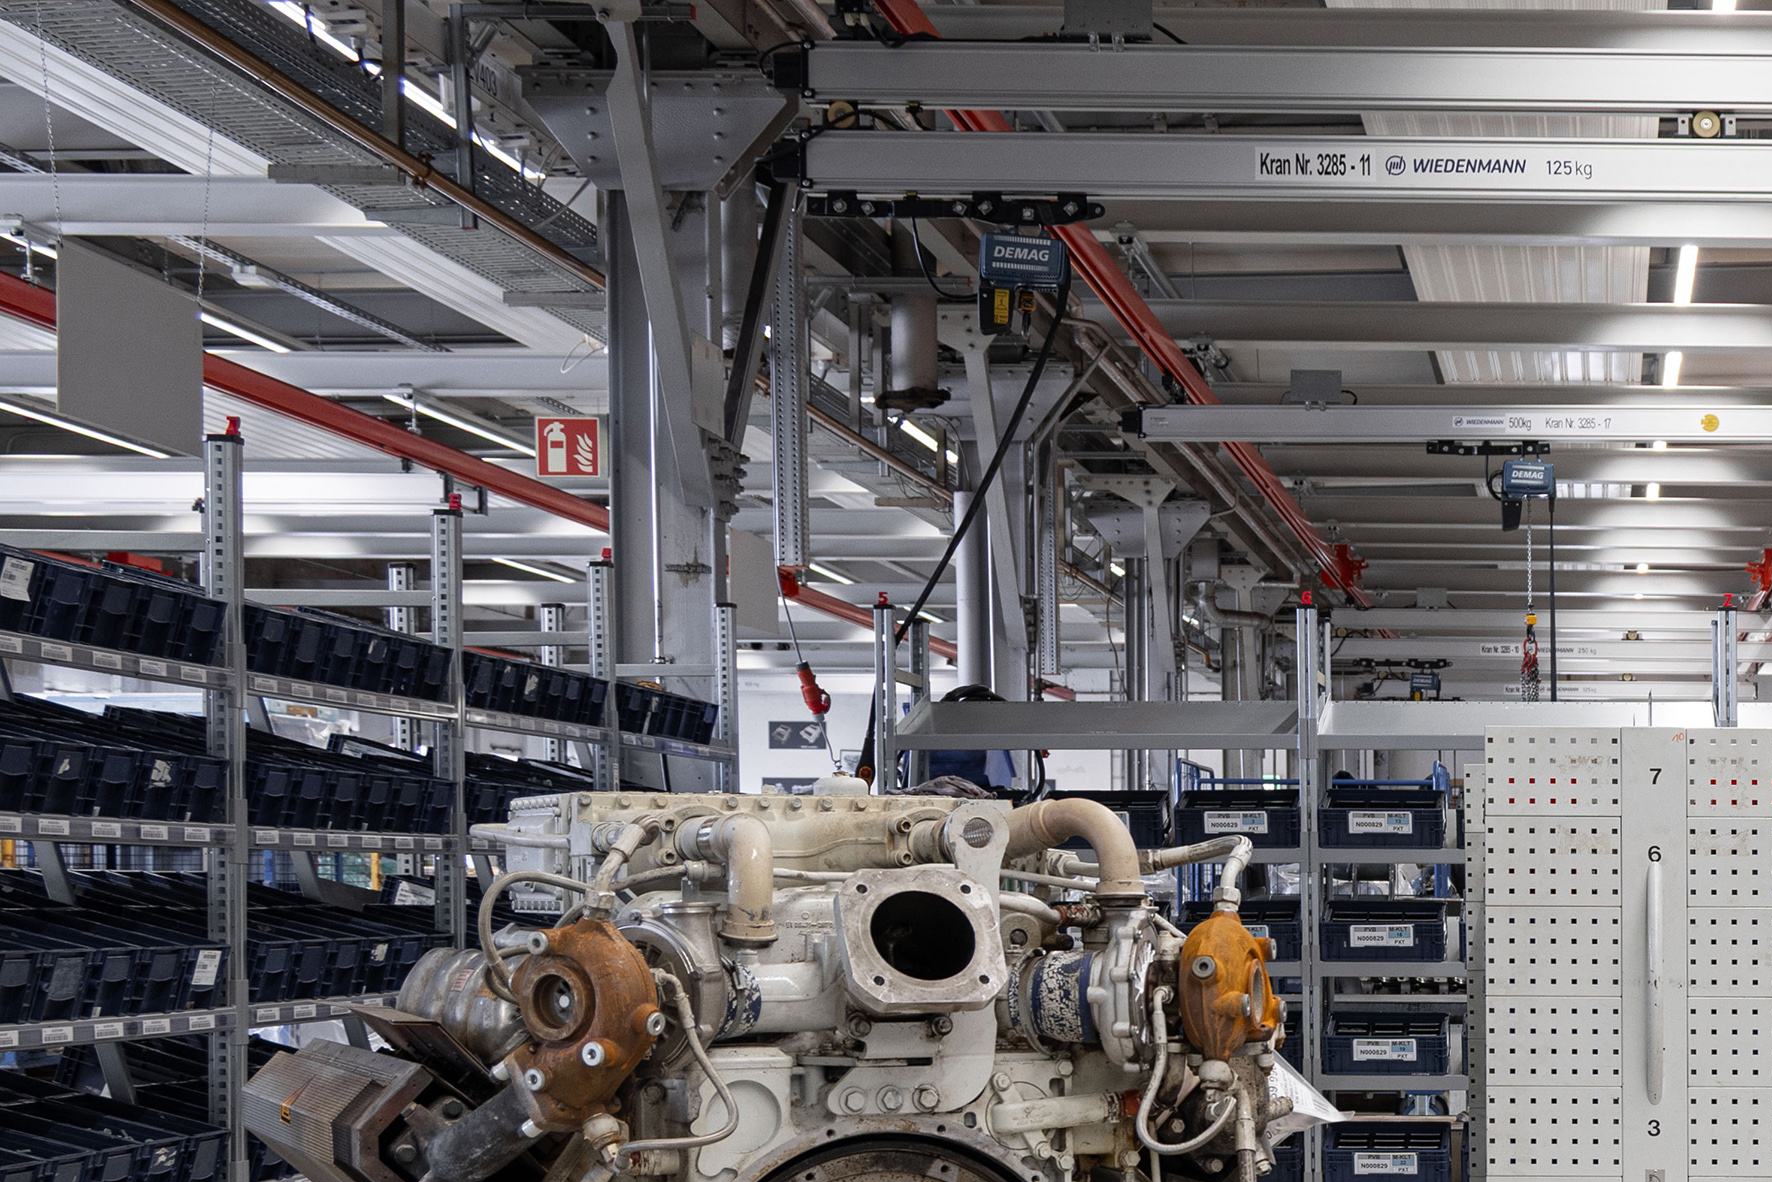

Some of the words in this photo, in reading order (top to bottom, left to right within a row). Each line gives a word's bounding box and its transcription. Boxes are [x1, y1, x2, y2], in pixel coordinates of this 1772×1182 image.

[1260, 152, 1290, 176] Kran
[1296, 154, 1312, 176] Nr.
[1316, 154, 1346, 176] 3285
[1359, 154, 1371, 176] 11
[1412, 158, 1526, 174] WIEDENMANN
[993, 246, 1050, 262] DEMAG
[1509, 417, 1532, 431] 500kg
[1545, 418, 1563, 428] Kran
[1566, 418, 1575, 428] Nr.
[1578, 418, 1595, 429] 3285
[1604, 418, 1611, 429] 17
[1512, 470, 1544, 480] DEMAG
[878, 592, 888, 605] 5
[1301, 590, 1312, 604] 6
[1482, 645, 1492, 653] Kran
[1650, 768, 1662, 784] 7
[1648, 845, 1662, 862] 6
[1648, 1119, 1661, 1136] 3
